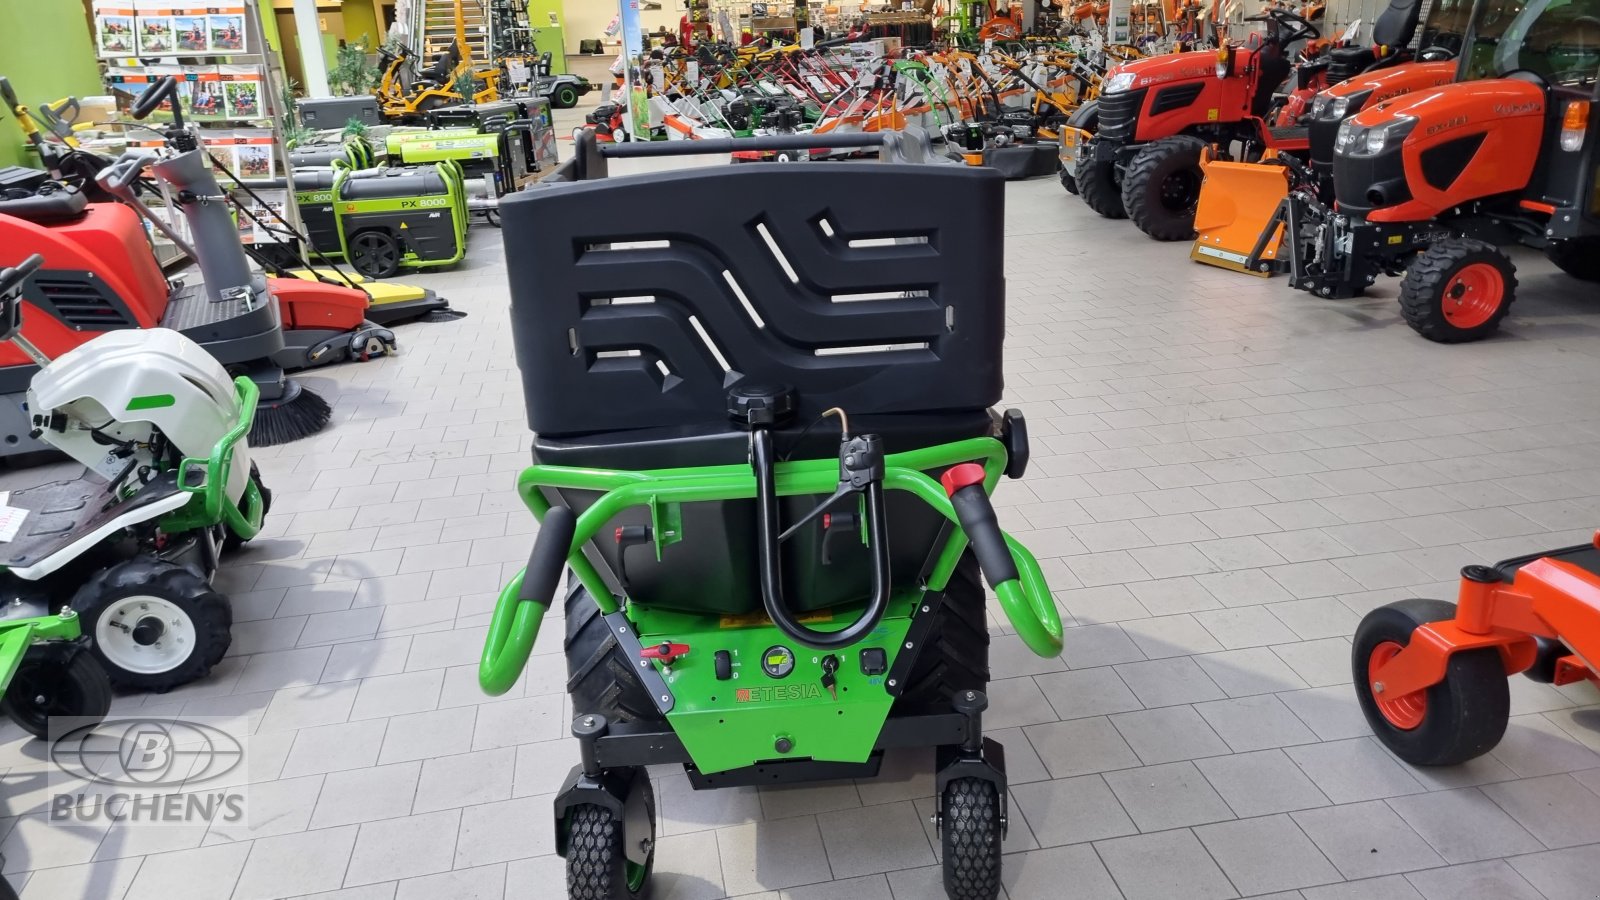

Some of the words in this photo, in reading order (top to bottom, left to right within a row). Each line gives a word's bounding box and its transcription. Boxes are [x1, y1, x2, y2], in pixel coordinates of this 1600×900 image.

[1493, 102, 1541, 113] Kubota
[401, 200, 417, 208] PX
[420, 198, 446, 207] 8000
[812, 656, 818, 664] 0
[733, 672, 739, 680] 0
